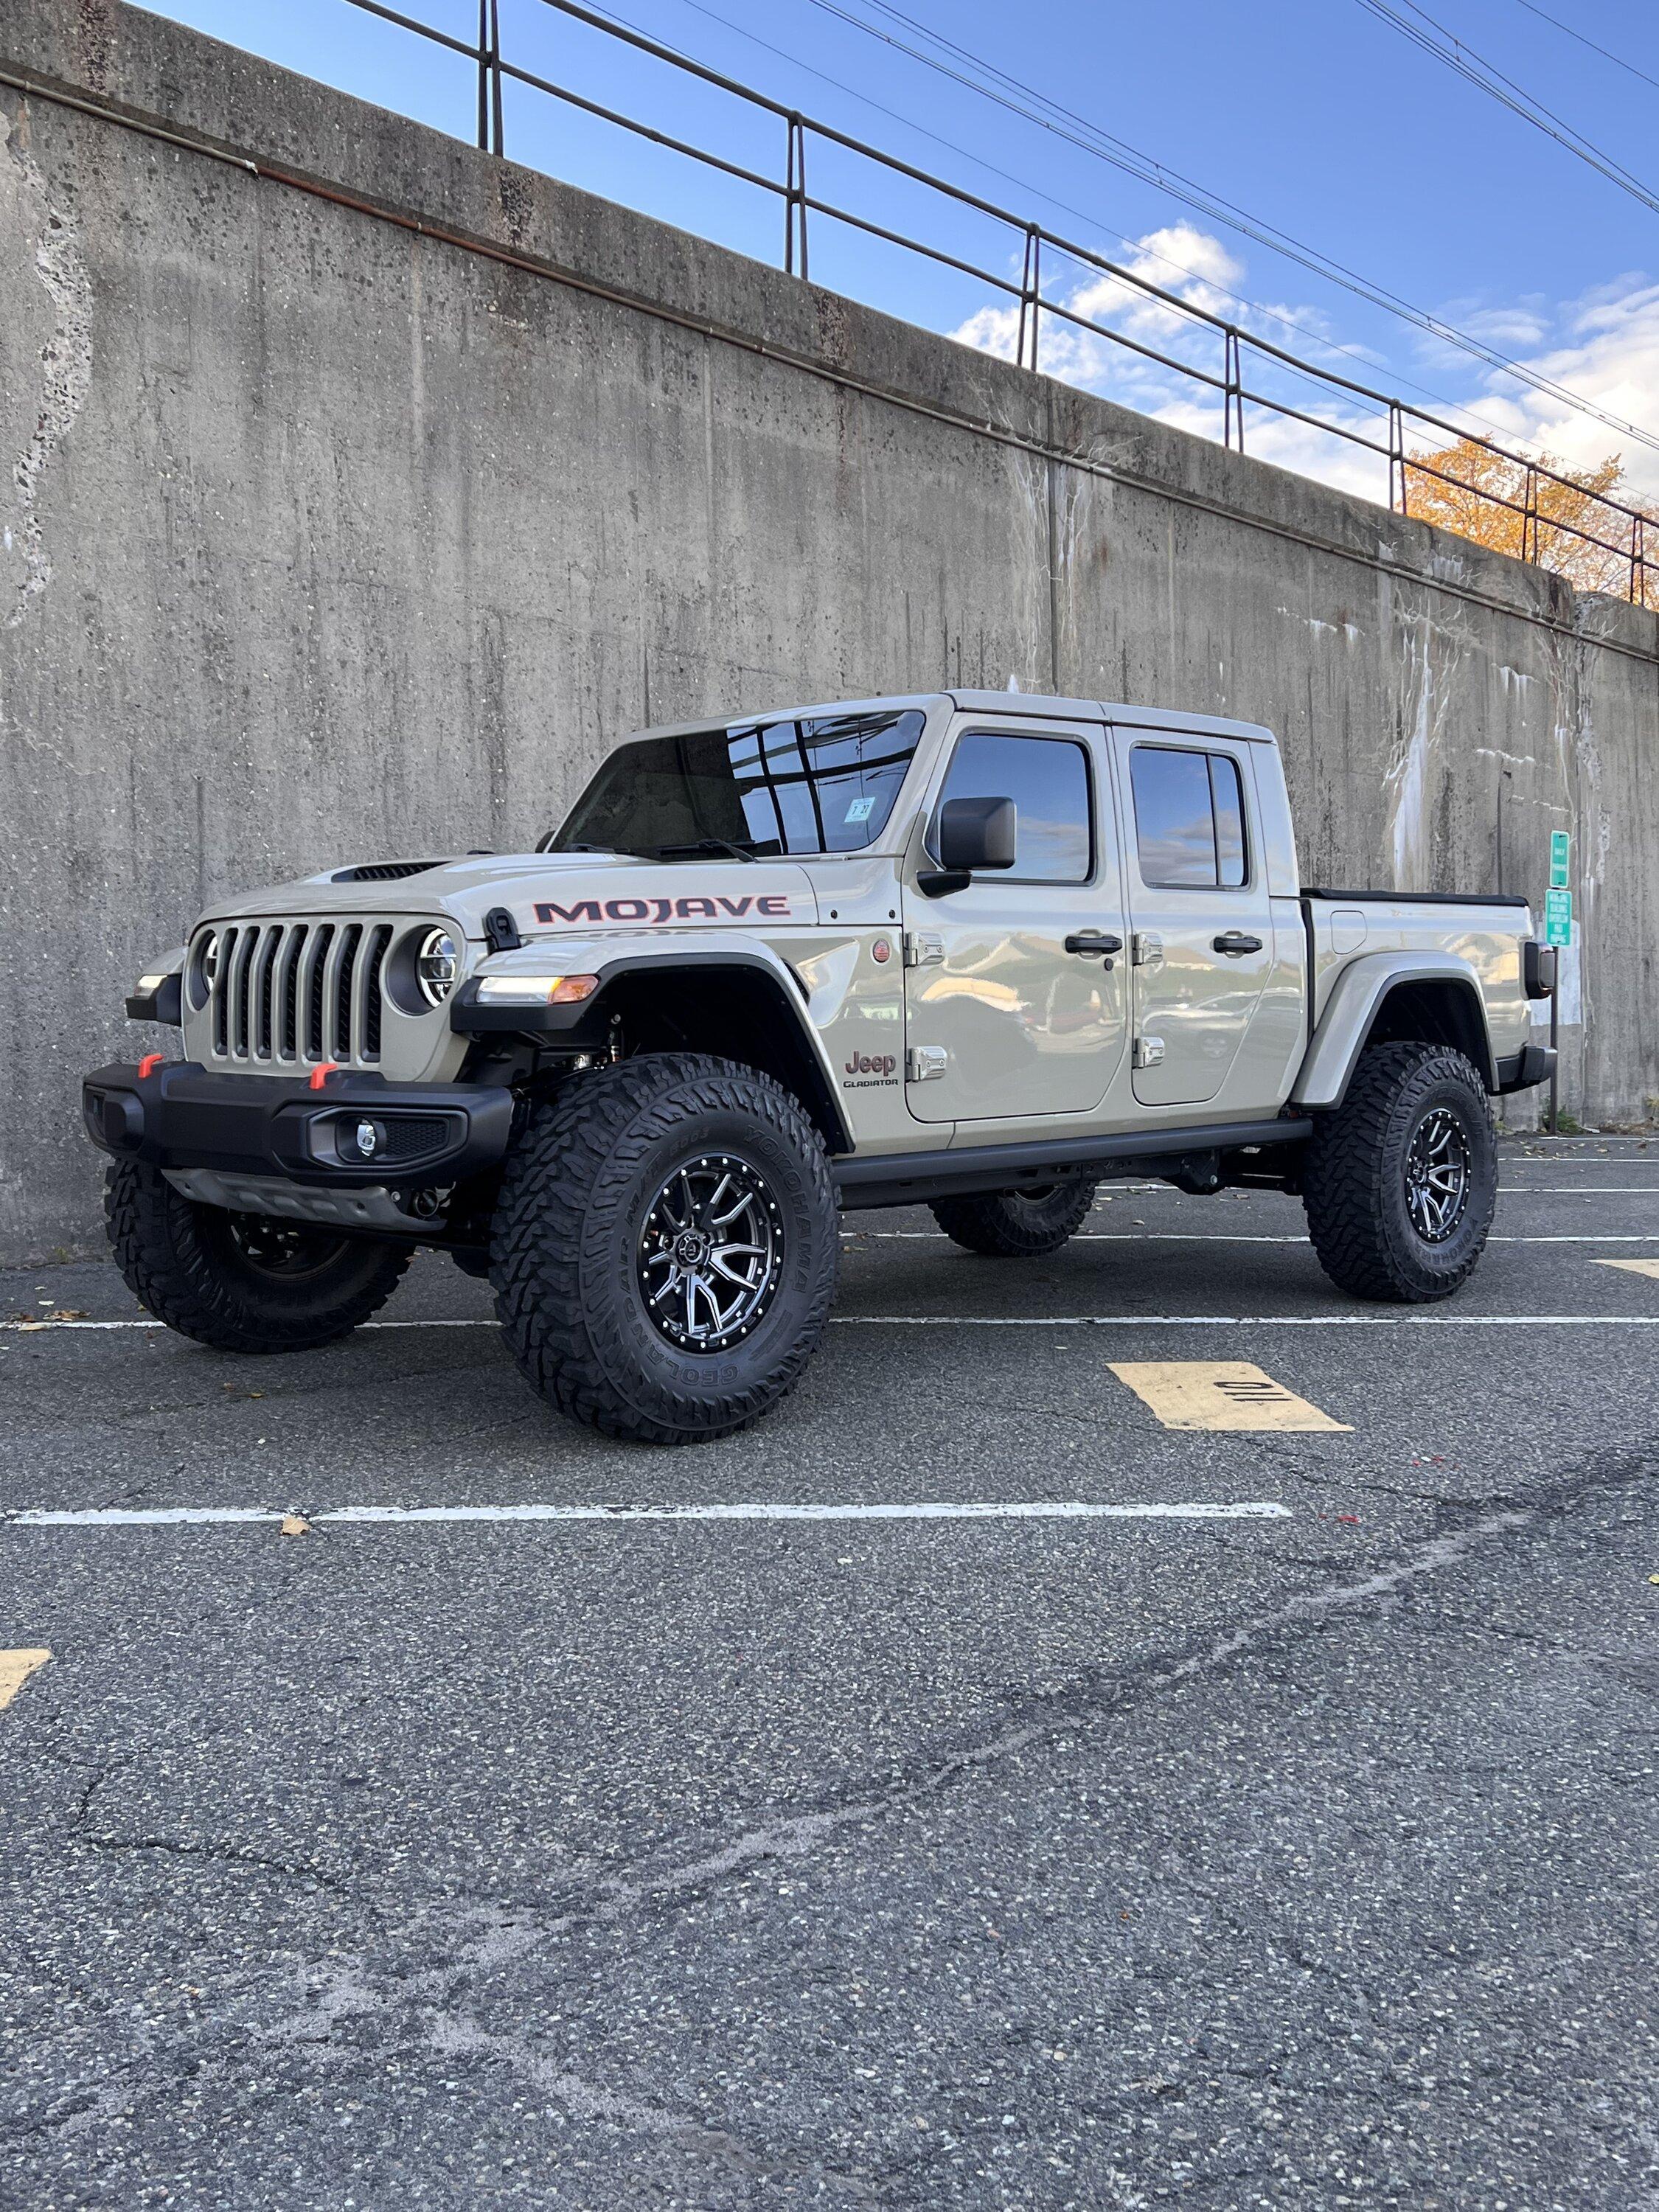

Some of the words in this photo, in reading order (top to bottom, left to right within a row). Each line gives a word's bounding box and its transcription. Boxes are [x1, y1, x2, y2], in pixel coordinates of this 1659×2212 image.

[532, 896, 791, 923] MOJAVE
[845, 1050, 897, 1077] Jeep
[843, 1079, 899, 1088] GLADIATOR
[744, 1124, 812, 1293] YOKOHAMA
[618, 1235, 740, 1387] GEOLANDAR
